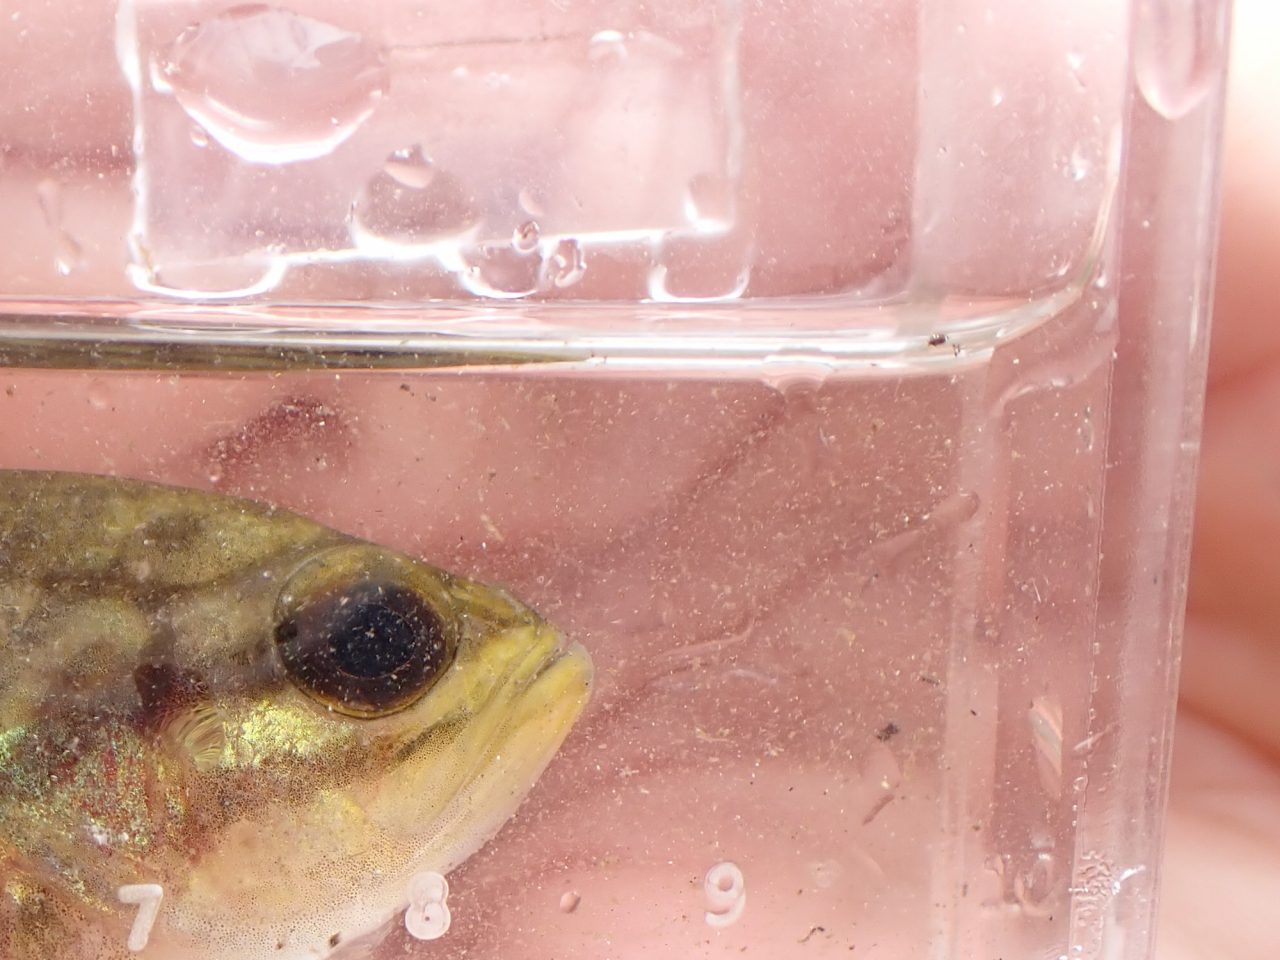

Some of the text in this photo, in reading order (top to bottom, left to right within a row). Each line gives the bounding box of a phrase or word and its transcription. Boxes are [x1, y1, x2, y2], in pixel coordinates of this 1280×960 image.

[118, 884, 164, 952] 7
[405, 871, 451, 941] 8
[704, 862, 747, 927] 9
